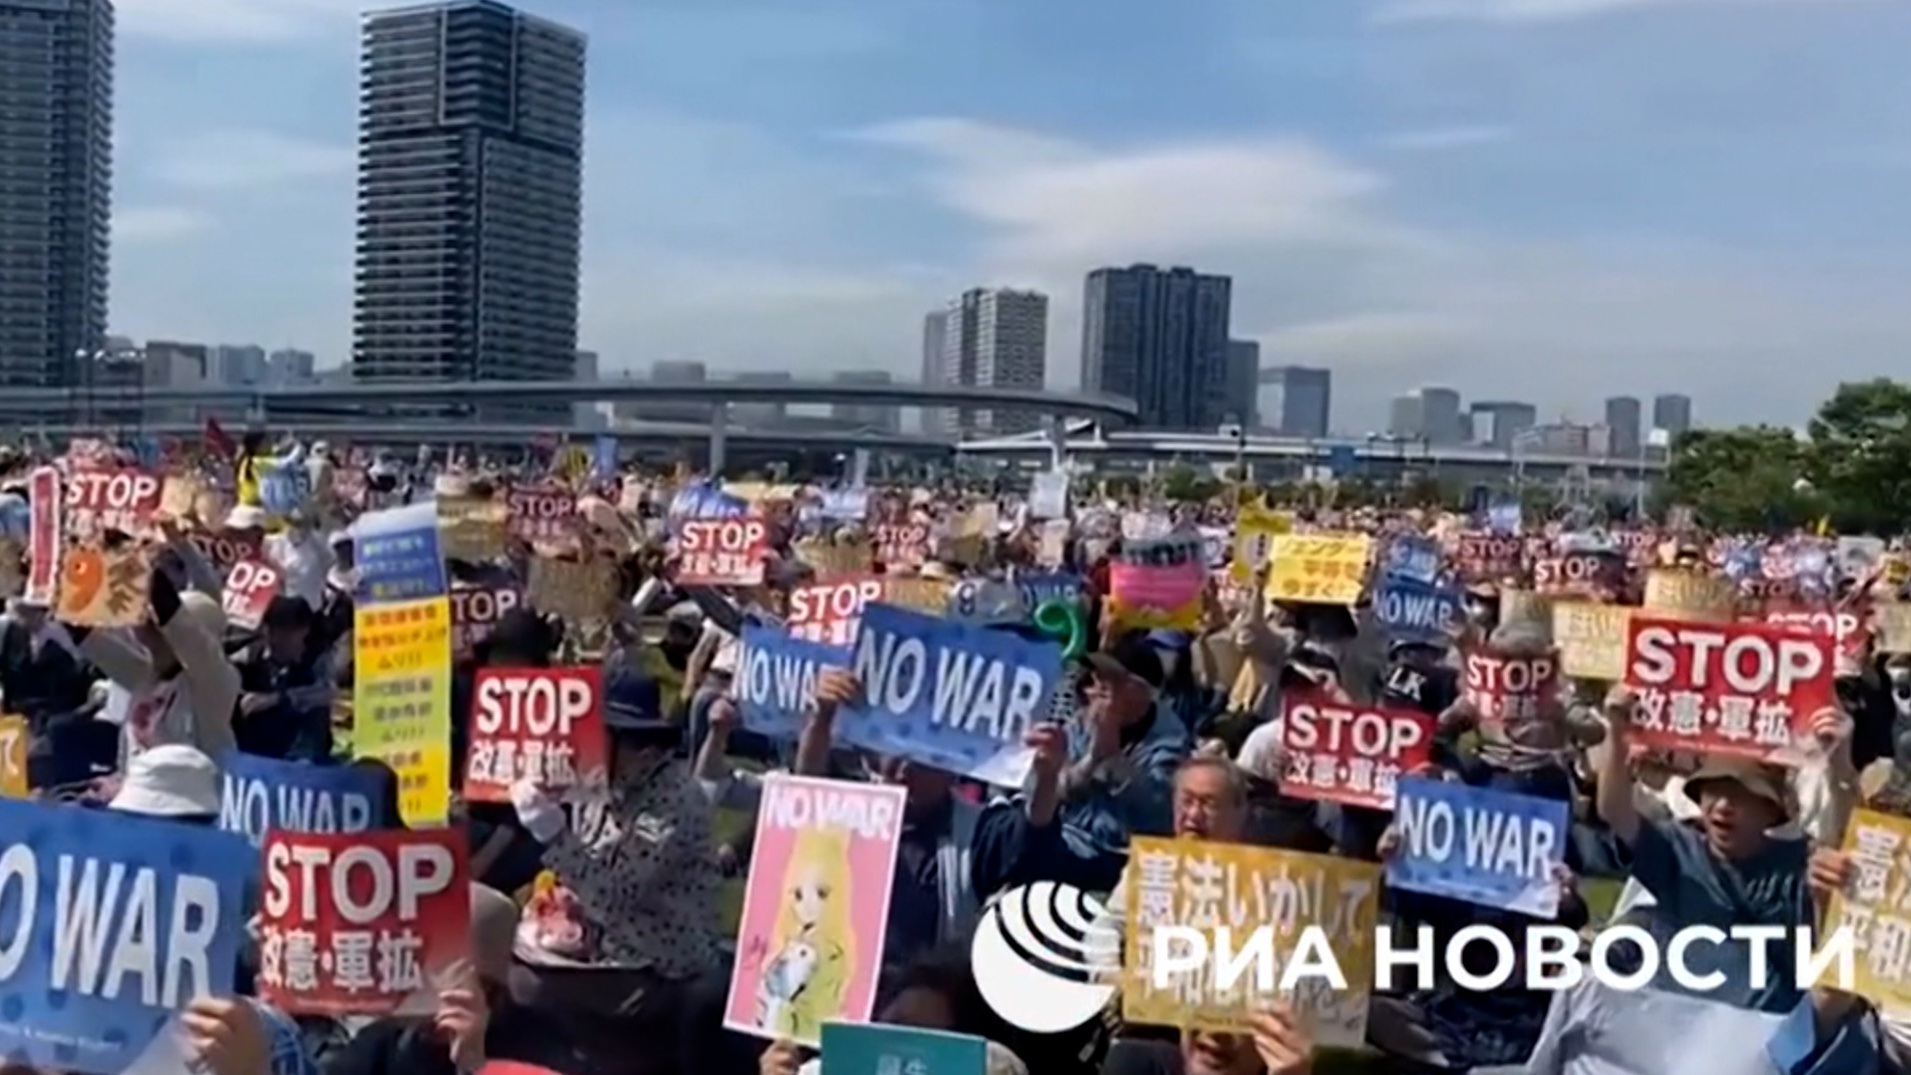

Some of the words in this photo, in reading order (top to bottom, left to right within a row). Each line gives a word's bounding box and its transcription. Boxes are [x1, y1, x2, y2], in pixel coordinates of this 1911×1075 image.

[67, 472, 158, 508] STOP
[510, 493, 572, 517] STOP
[191, 532, 252, 563] TOP
[681, 521, 765, 550] STOP
[879, 525, 926, 544] STOP
[1463, 538, 1520, 558] STOP
[227, 561, 277, 593] OP
[1534, 556, 1600, 582] STOP
[452, 590, 517, 622] TOP
[790, 579, 882, 622] STOP
[1373, 589, 1400, 622] NO
[1404, 597, 1454, 630] WAR
[731, 640, 770, 705] NO
[775, 655, 820, 713] WA
[1467, 654, 1552, 692] STOP
[1632, 626, 1823, 695] STOP
[477, 676, 592, 736] STOP
[854, 627, 926, 714] NO
[931, 647, 1042, 745] WAR
[1288, 704, 1423, 758] STOP
[220, 773, 269, 848] NO
[278, 784, 371, 834] WAR
[766, 785, 811, 831] NO
[814, 789, 895, 841] WAR
[1400, 793, 1454, 863] NO
[1464, 806, 1556, 882] WAR
[265, 841, 454, 924] STOP
[0, 842, 38, 981] O
[51, 854, 220, 1008] WAR
